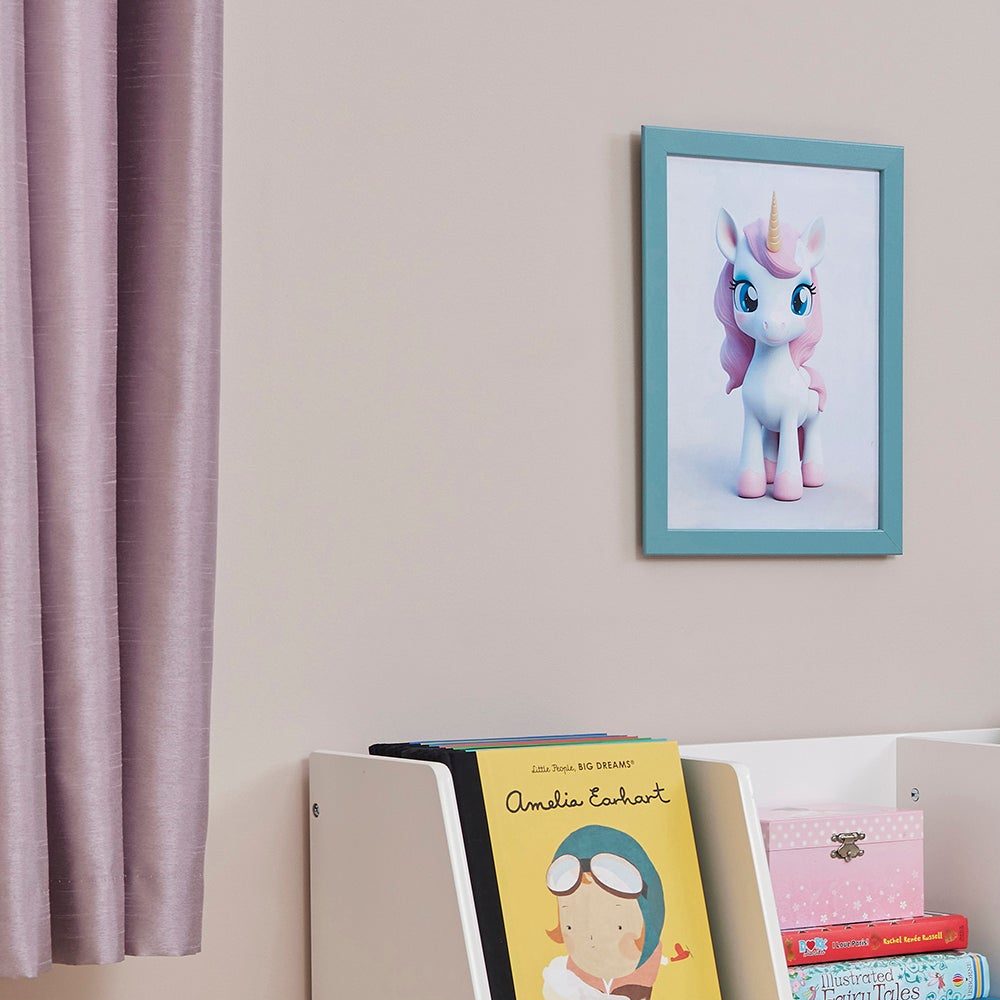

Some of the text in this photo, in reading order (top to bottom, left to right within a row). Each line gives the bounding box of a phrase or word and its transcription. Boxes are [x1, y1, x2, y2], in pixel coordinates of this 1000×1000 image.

[531, 764, 551, 774] Little
[578, 762, 593, 771] BIG
[506, 782, 671, 813] Amelia Earhart
[883, 936, 902, 945] Rachel
[922, 931, 943, 942] Russell
[821, 968, 894, 989] Illustrated
